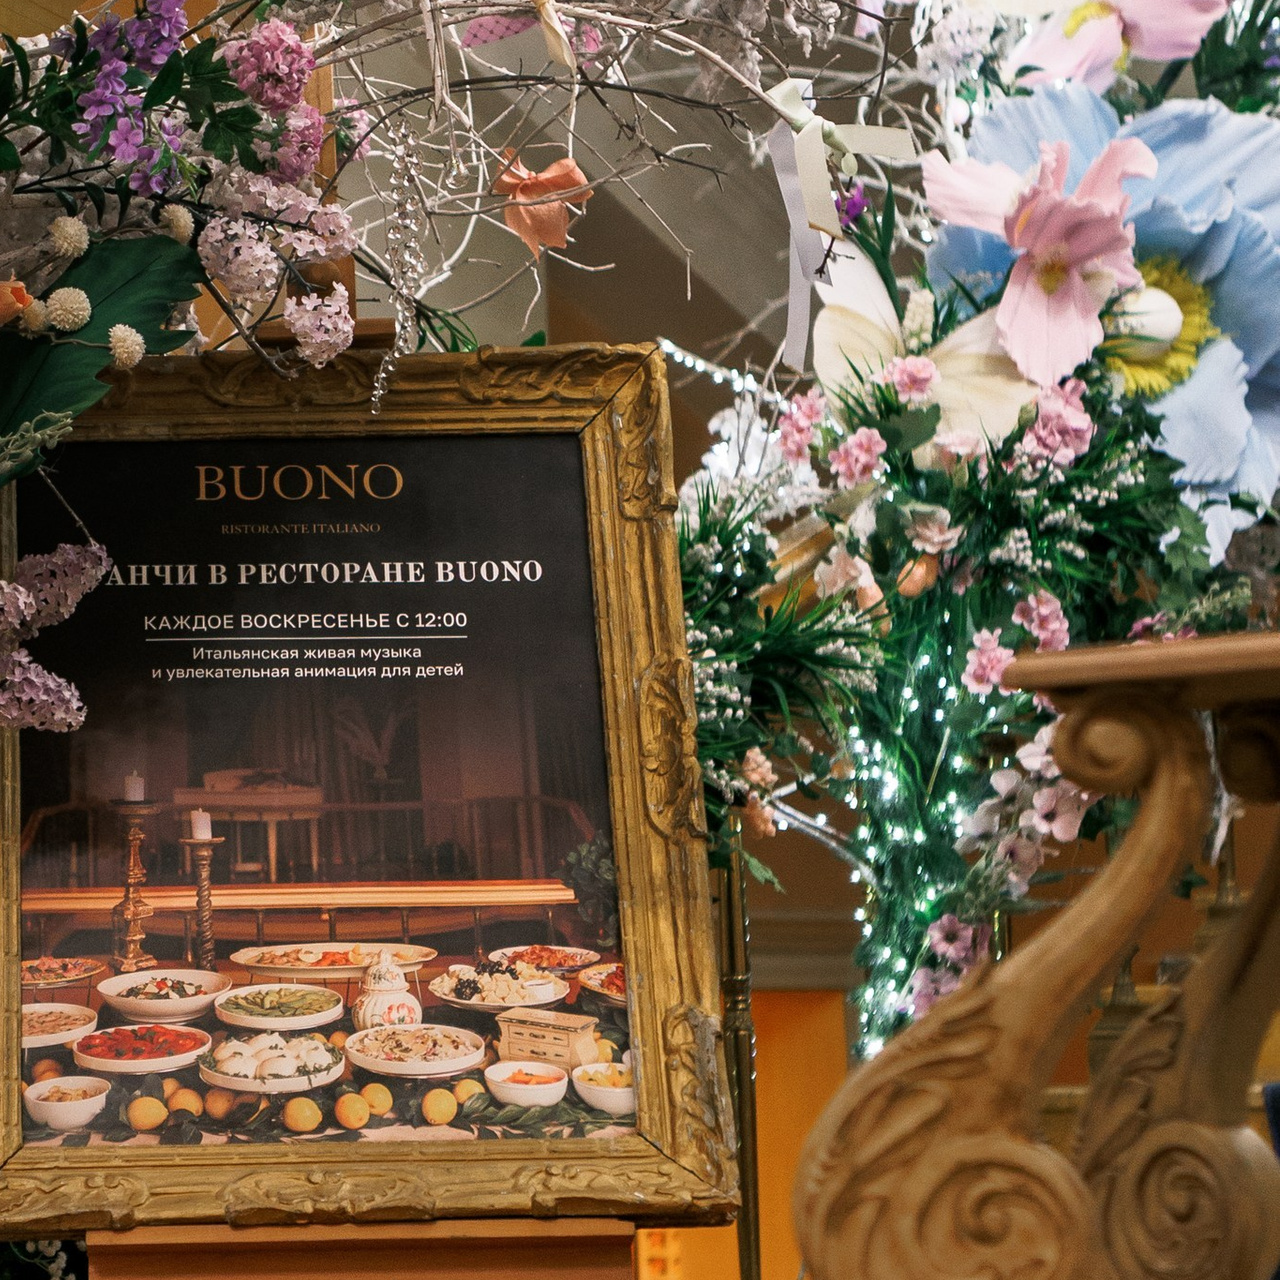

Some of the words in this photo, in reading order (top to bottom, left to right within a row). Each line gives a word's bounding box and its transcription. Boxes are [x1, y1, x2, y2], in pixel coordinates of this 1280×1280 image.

[195, 463, 405, 501] BUONO
[221, 523, 310, 535] RISTORANTE
[312, 522, 382, 534] ITALIANO
[105, 564, 197, 586] АНЧИ
[208, 564, 228, 585] В
[238, 561, 426, 586] РЕСТОРАНЕ
[434, 559, 544, 584] BUONO
[143, 614, 235, 632] КАЖДОЕ
[240, 613, 391, 630] ВОСКРЕСЕНЬЕ
[396, 612, 410, 628] С
[414, 612, 468, 628] 12:00
[192, 646, 299, 660] Итальянская
[303, 648, 356, 659] живая
[360, 647, 422, 662] музыка
[151, 668, 163, 679] и
[166, 667, 290, 682] увлекательная
[294, 666, 377, 680] анимация
[380, 666, 411, 679] для
[415, 662, 464, 679] детей
